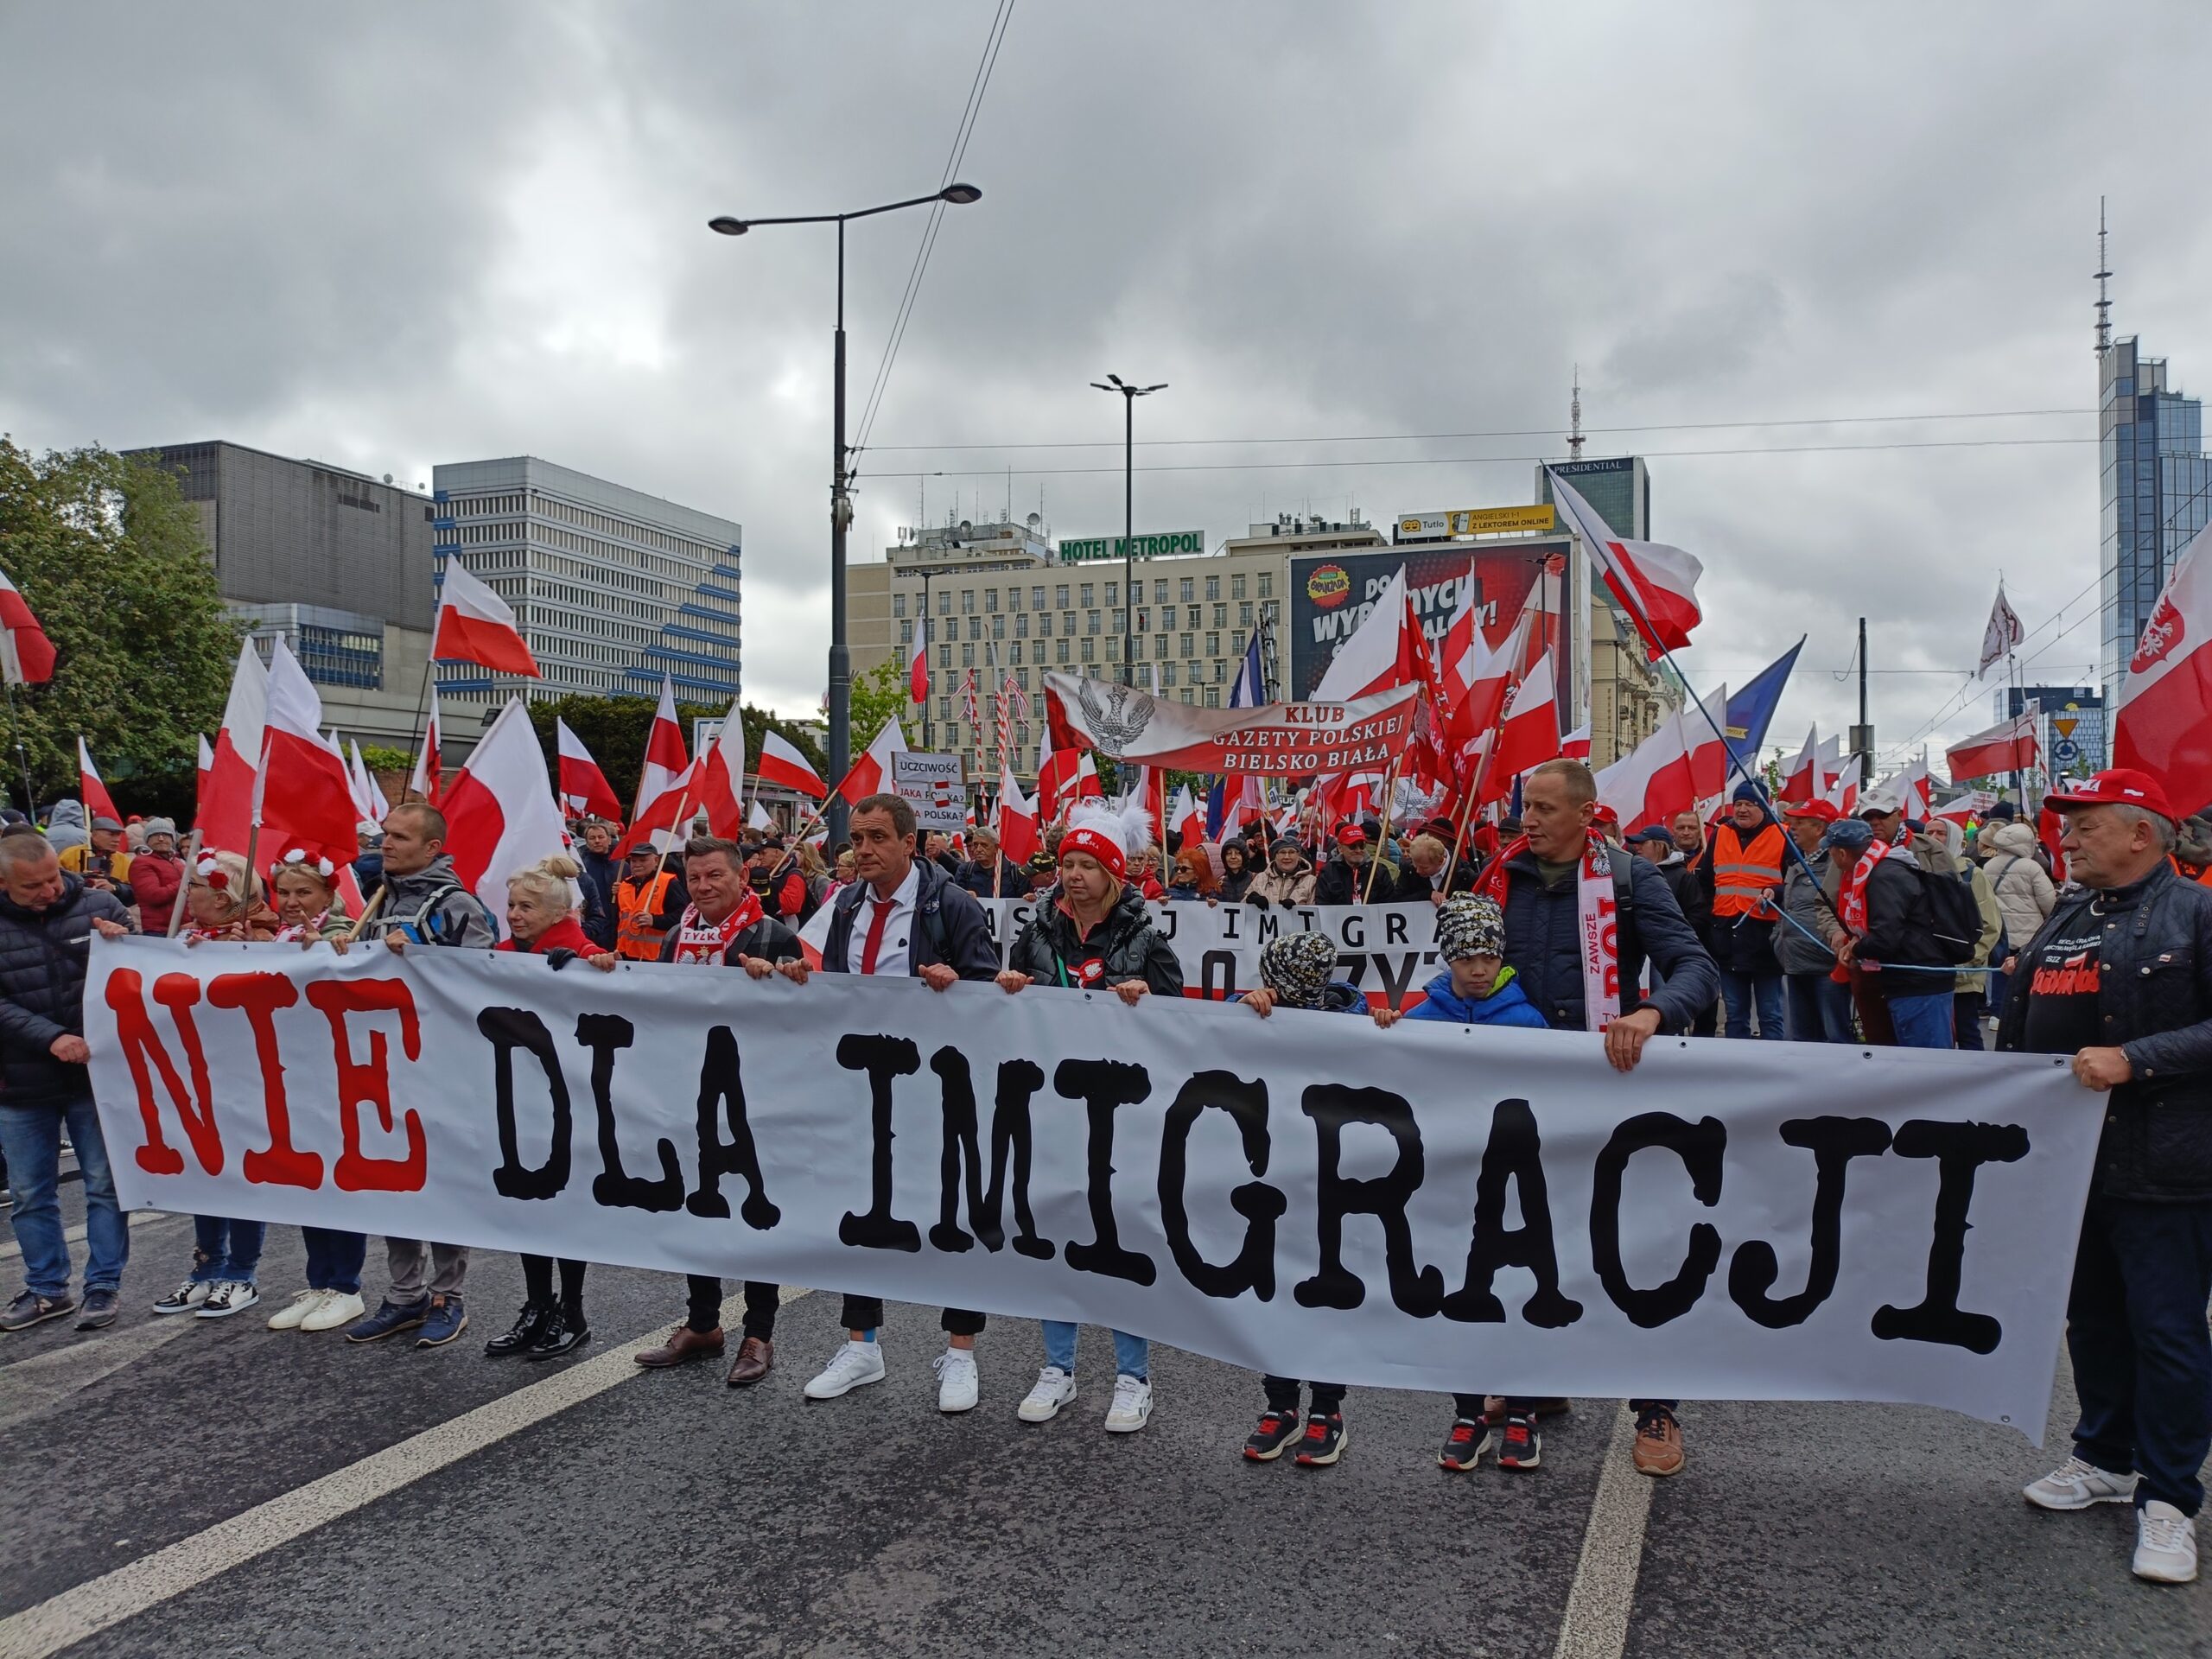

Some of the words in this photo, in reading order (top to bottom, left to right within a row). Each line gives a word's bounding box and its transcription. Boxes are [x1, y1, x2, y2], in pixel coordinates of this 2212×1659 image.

[1554, 461, 1622, 474] PRESIDENTIAL
[1478, 519, 1519, 529] LEKTOREM
[1521, 518, 1549, 526] ONLINE
[1061, 540, 1110, 561] HOTEL
[1115, 534, 1202, 557] METROPOL
[1285, 707, 1345, 722] KLUB
[1212, 730, 1301, 747] GAZETY
[1308, 714, 1404, 747] POLSKIEJ
[1224, 753, 1319, 770] BIELSKO
[1326, 743, 1389, 767] BIAŁA
[899, 761, 958, 773] UCZCIWOŚĆ
[899, 788, 922, 798] JAKA
[925, 810, 964, 821] POLSKA?
[1585, 913, 1600, 975] ZAWSZE
[105, 967, 428, 1193] NIE
[476, 1006, 781, 1230] DLA
[836, 1033, 2031, 1355] IMIGRACJI
